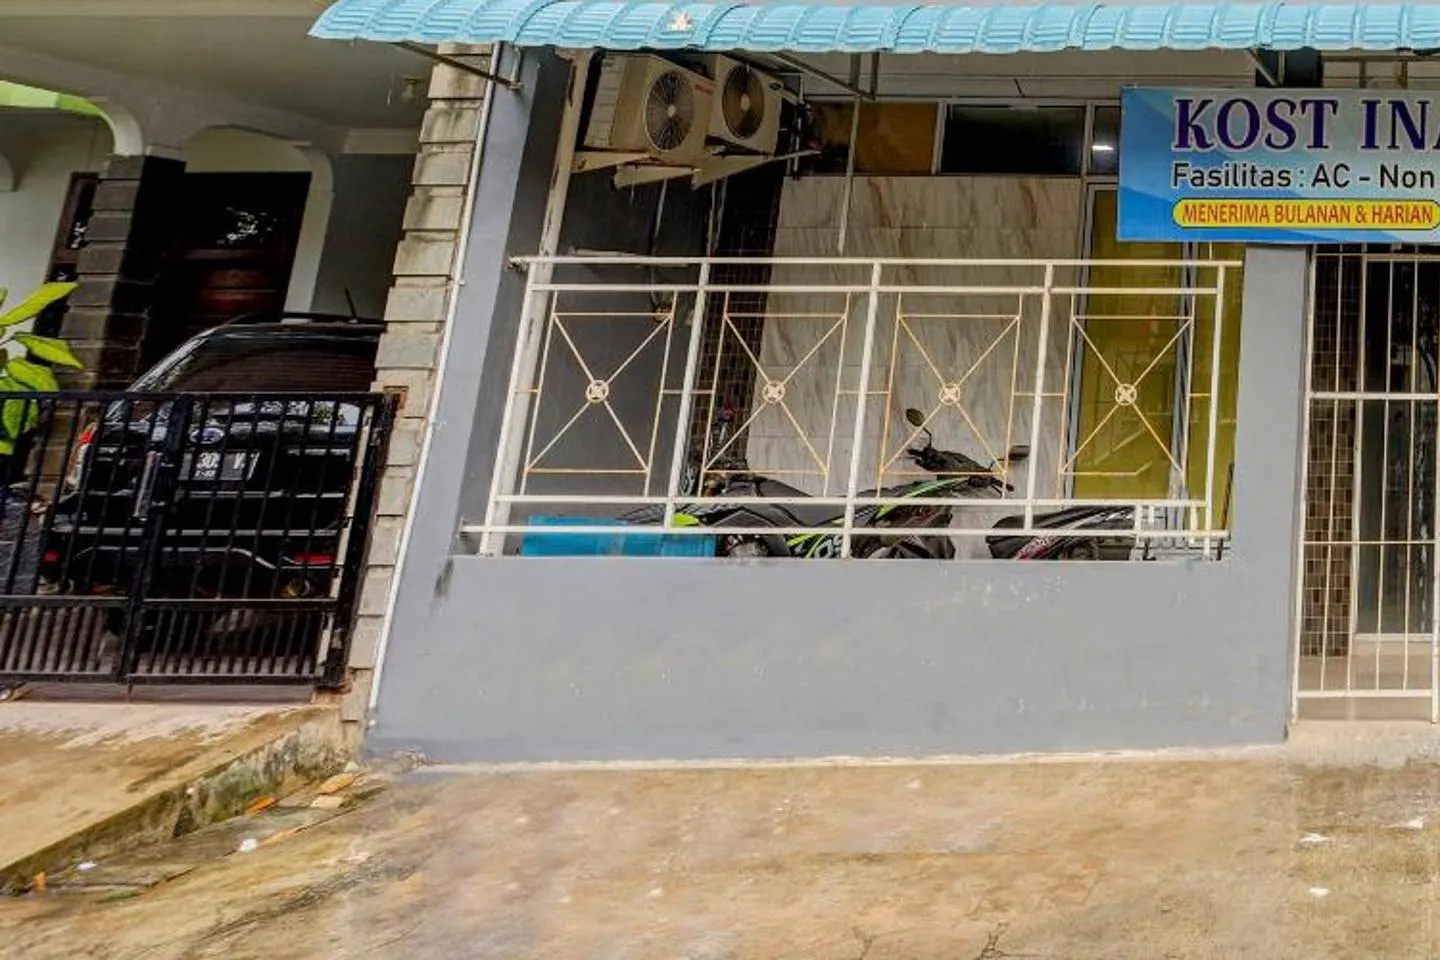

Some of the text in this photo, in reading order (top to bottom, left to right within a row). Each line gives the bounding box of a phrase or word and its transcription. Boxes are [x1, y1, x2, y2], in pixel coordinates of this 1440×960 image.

[1174, 98, 1338, 149] KOST
[1173, 162, 1291, 188] Fasilitas
[1311, 163, 1350, 188] AC
[1380, 164, 1434, 188] Non
[1182, 204, 1433, 224] MENERIMA BULANAN & HARIAN
